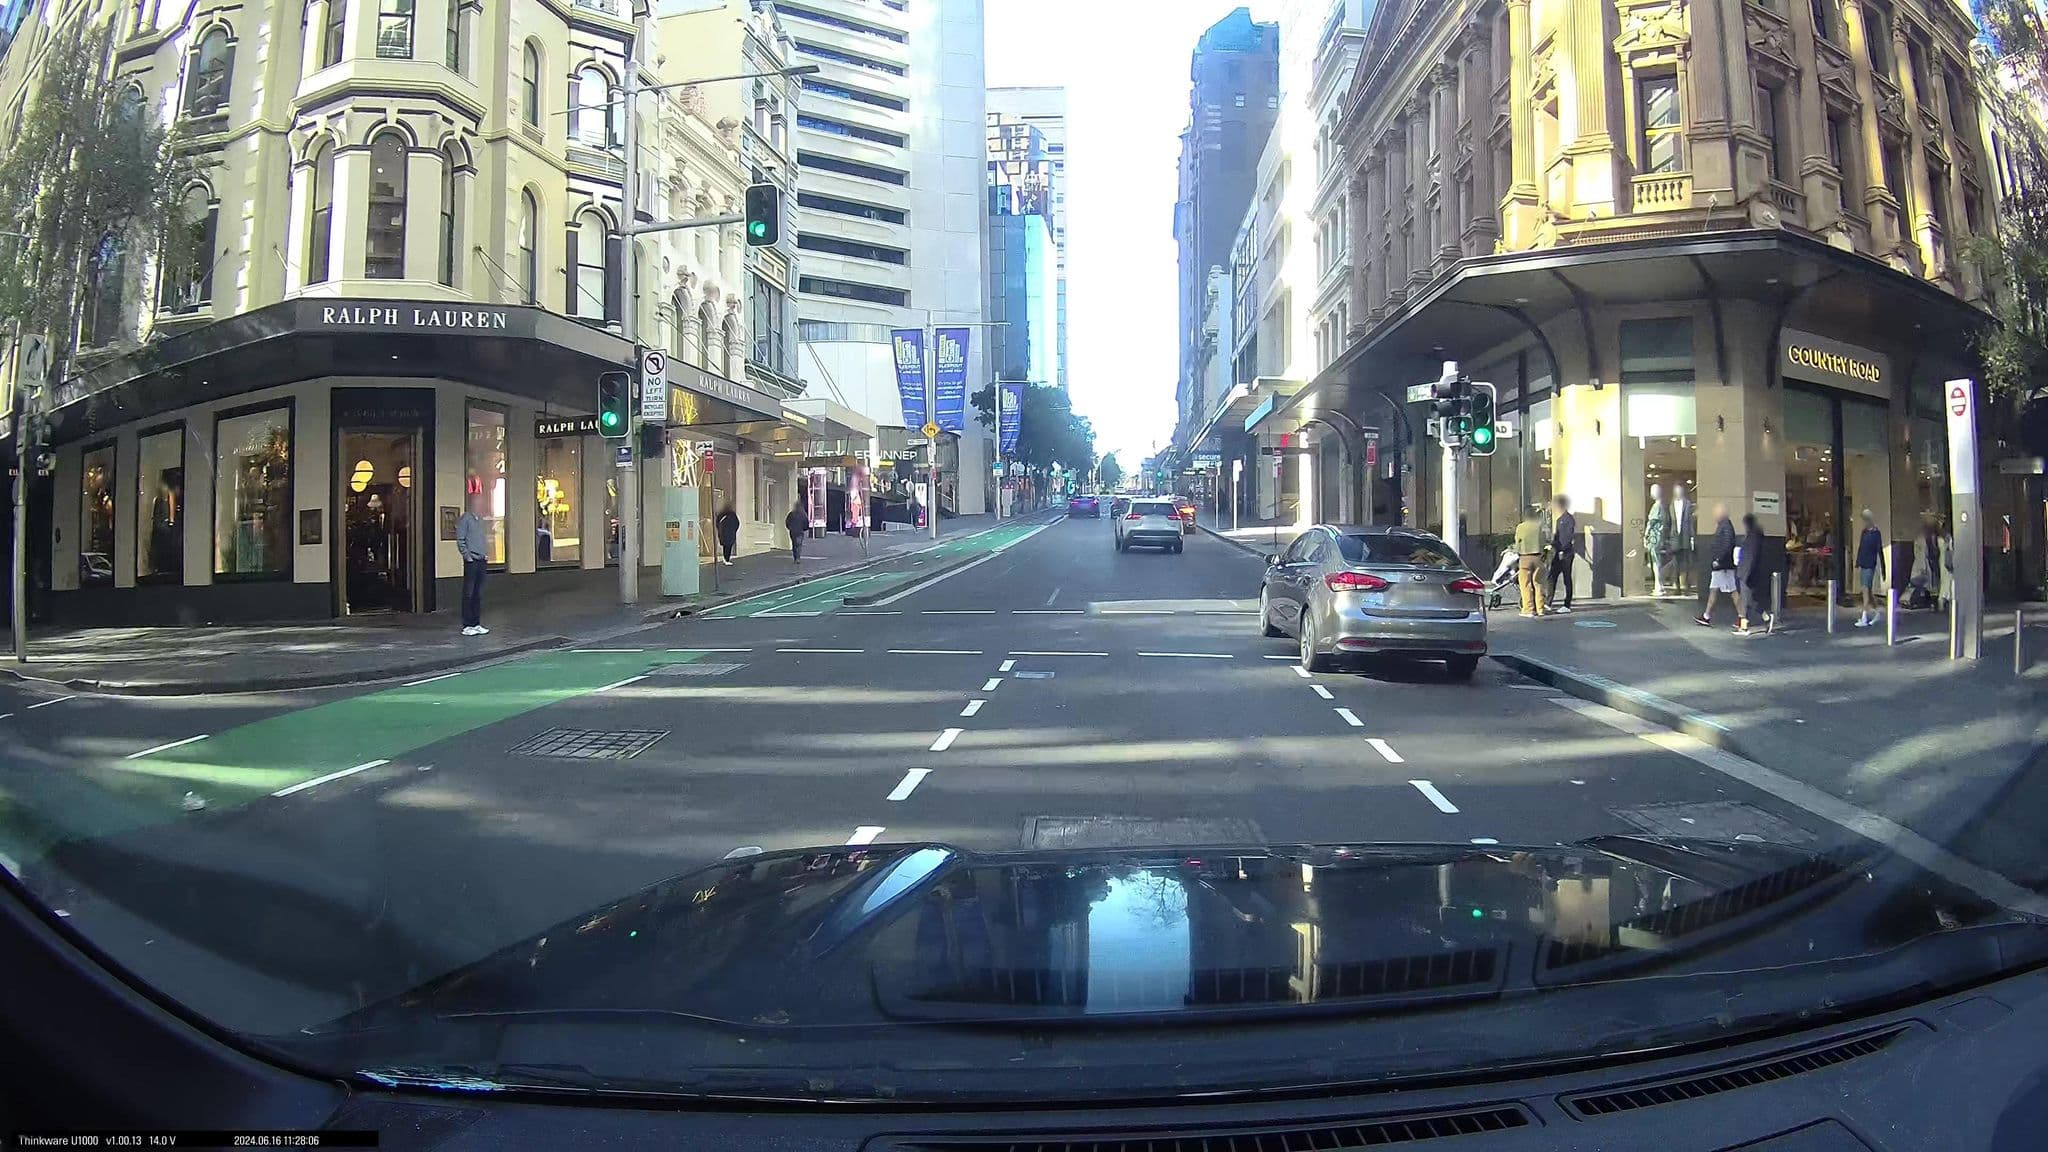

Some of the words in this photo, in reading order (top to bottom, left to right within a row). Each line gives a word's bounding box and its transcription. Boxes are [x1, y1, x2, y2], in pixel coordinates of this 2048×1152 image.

[323, 307, 399, 325] RALPH
[413, 309, 507, 329] LAUREN
[1788, 344, 1848, 376] COUNTRY
[1849, 358, 1881, 383] ROAD
[647, 377, 661, 386] NO
[699, 376, 723, 392] RALPH
[646, 387, 662, 395] LEFT
[539, 422, 574, 434] RALPH
